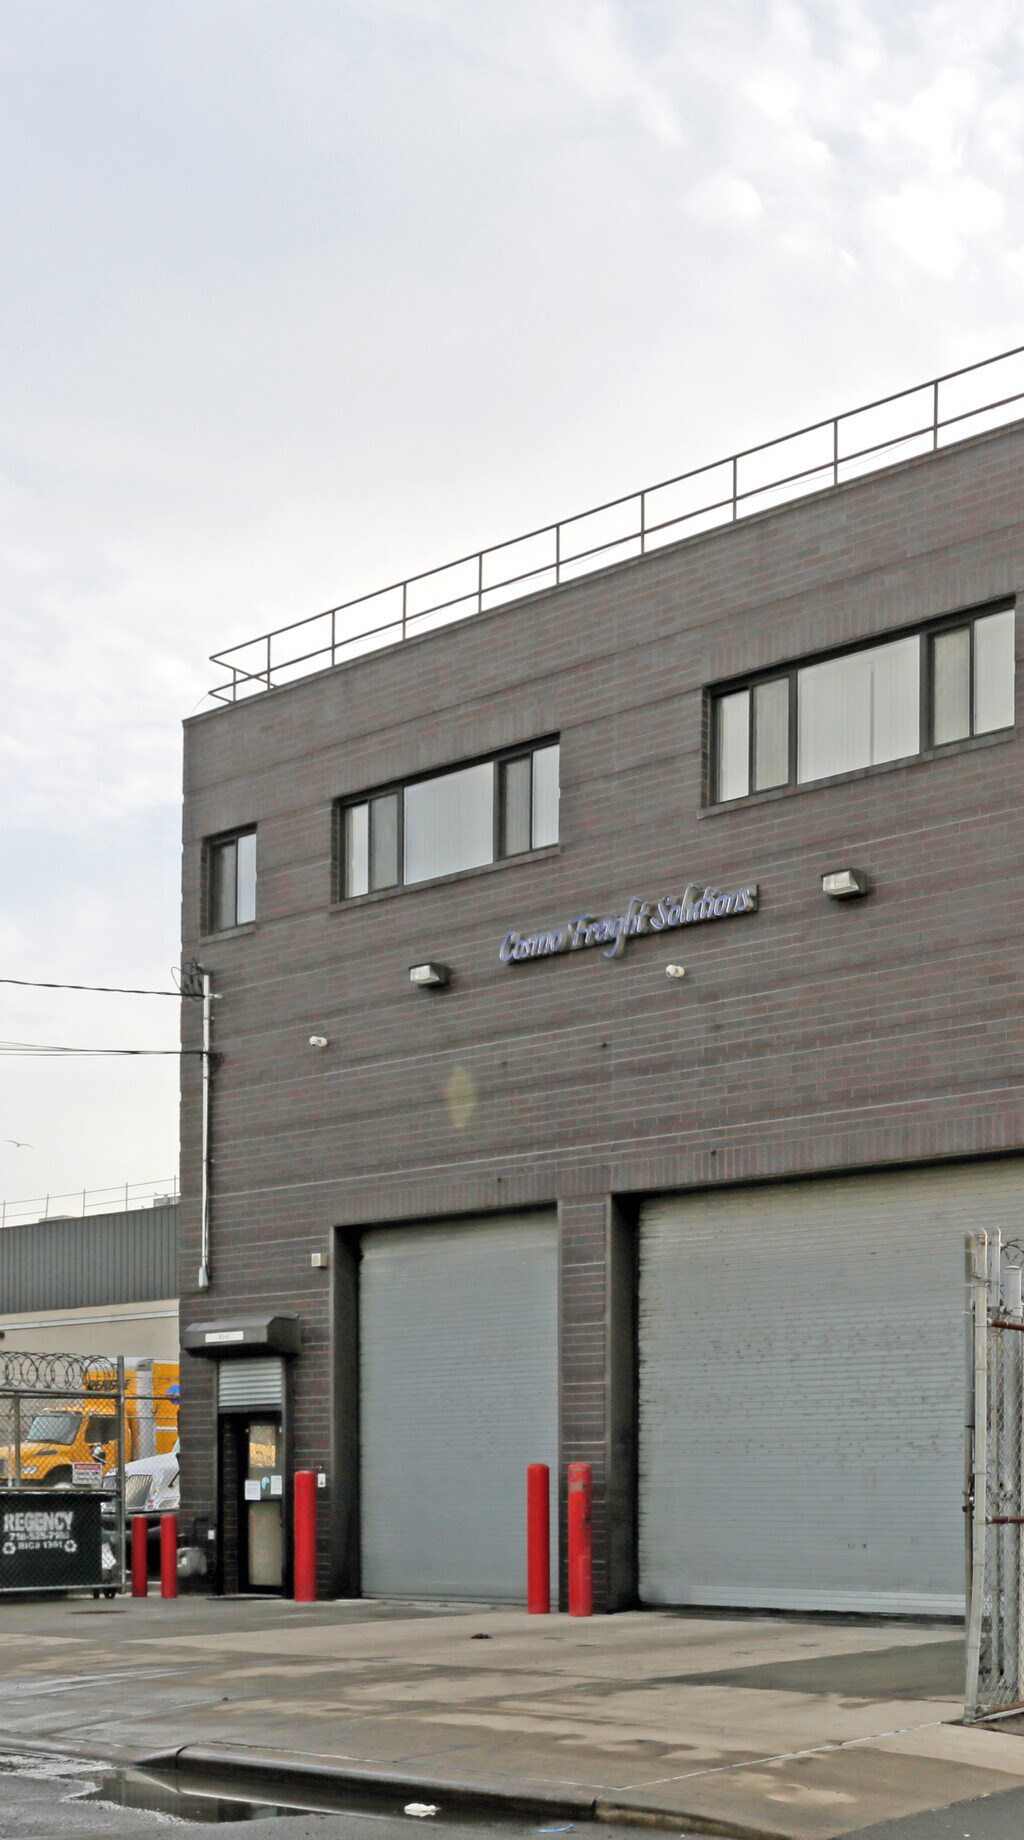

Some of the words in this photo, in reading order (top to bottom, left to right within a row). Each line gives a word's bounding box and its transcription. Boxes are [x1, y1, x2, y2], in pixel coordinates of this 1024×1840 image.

[499, 931, 564, 962] Cosmo
[567, 896, 650, 958] Freight
[650, 882, 754, 930] Solutions
[3, 1511, 74, 1532] REGENCY
